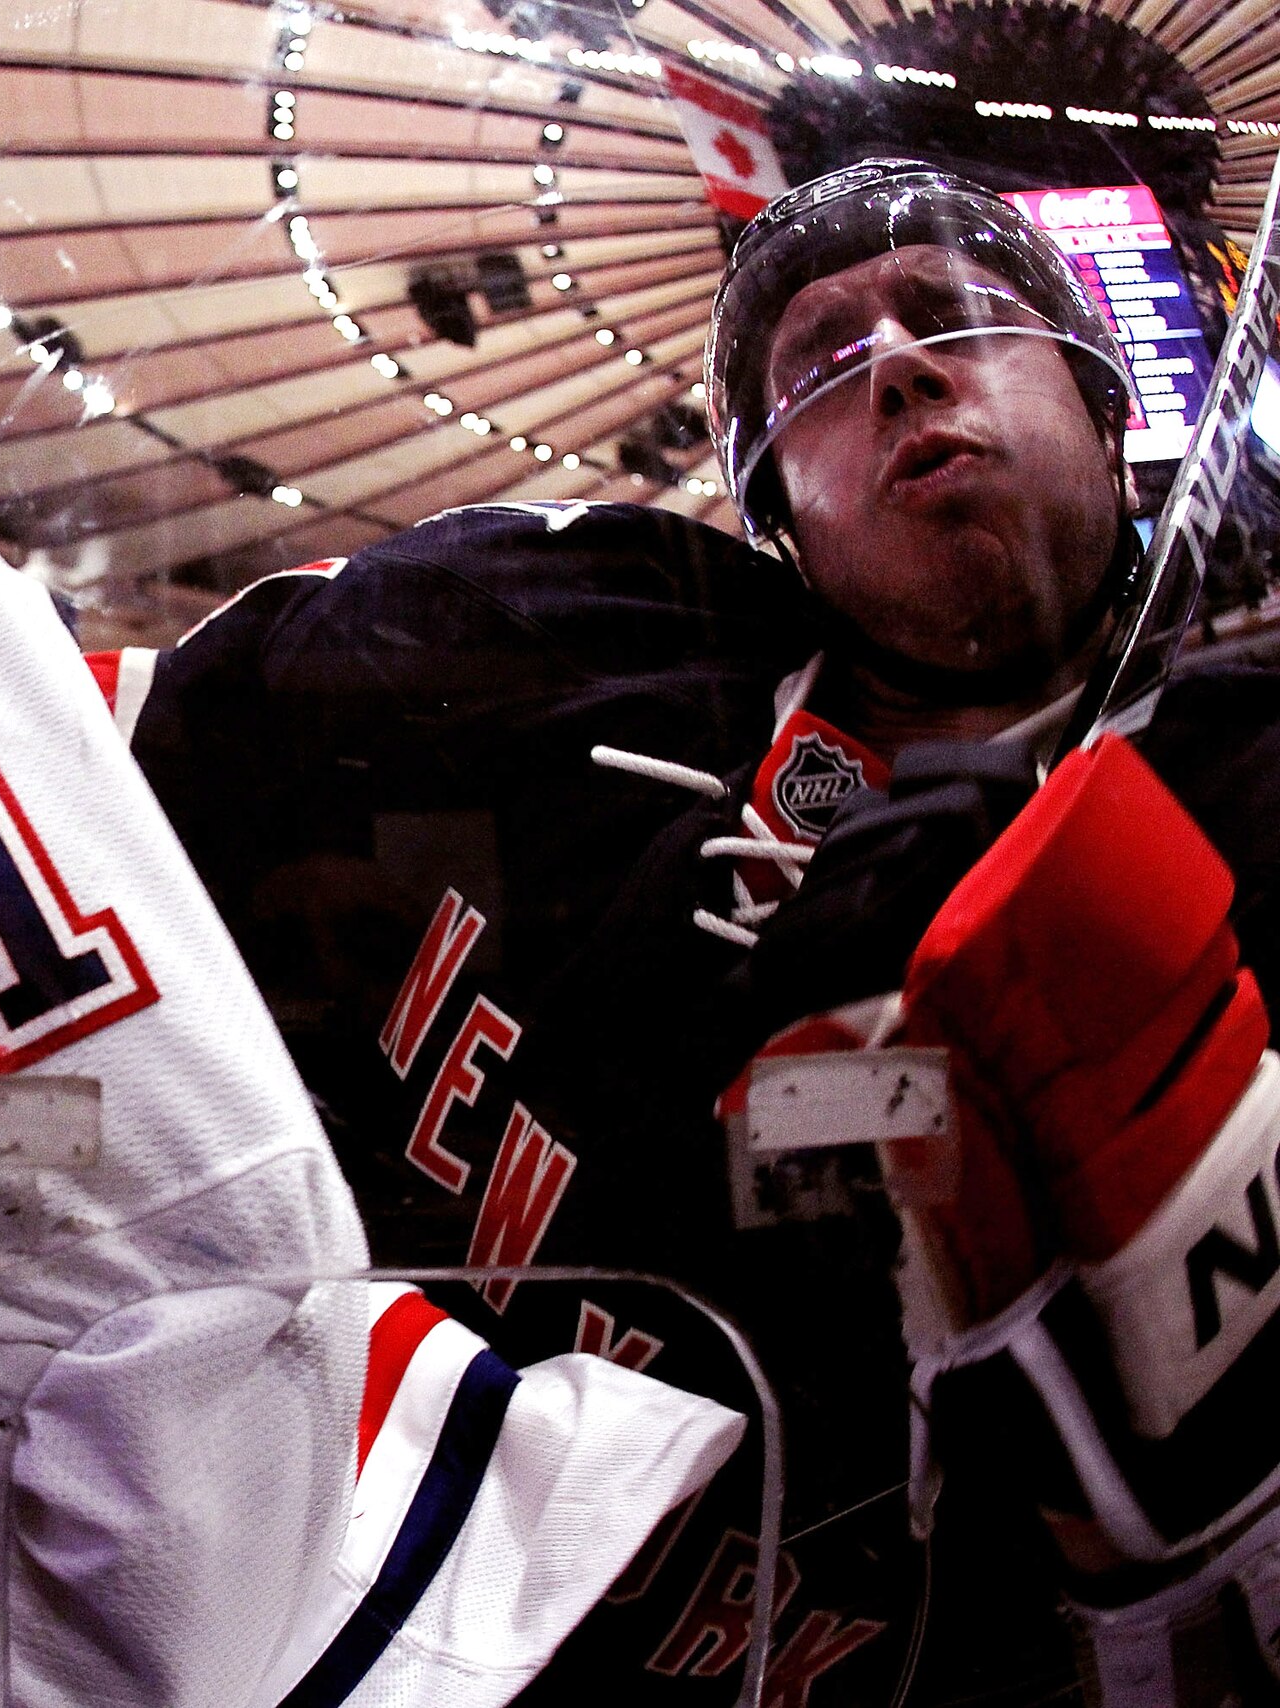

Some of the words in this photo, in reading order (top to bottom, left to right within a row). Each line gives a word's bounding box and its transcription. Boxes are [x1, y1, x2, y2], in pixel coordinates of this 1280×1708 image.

[1182, 266, 1278, 584] EASTON
[789, 778, 848, 803] NHL
[379, 886, 578, 1316] NEW
